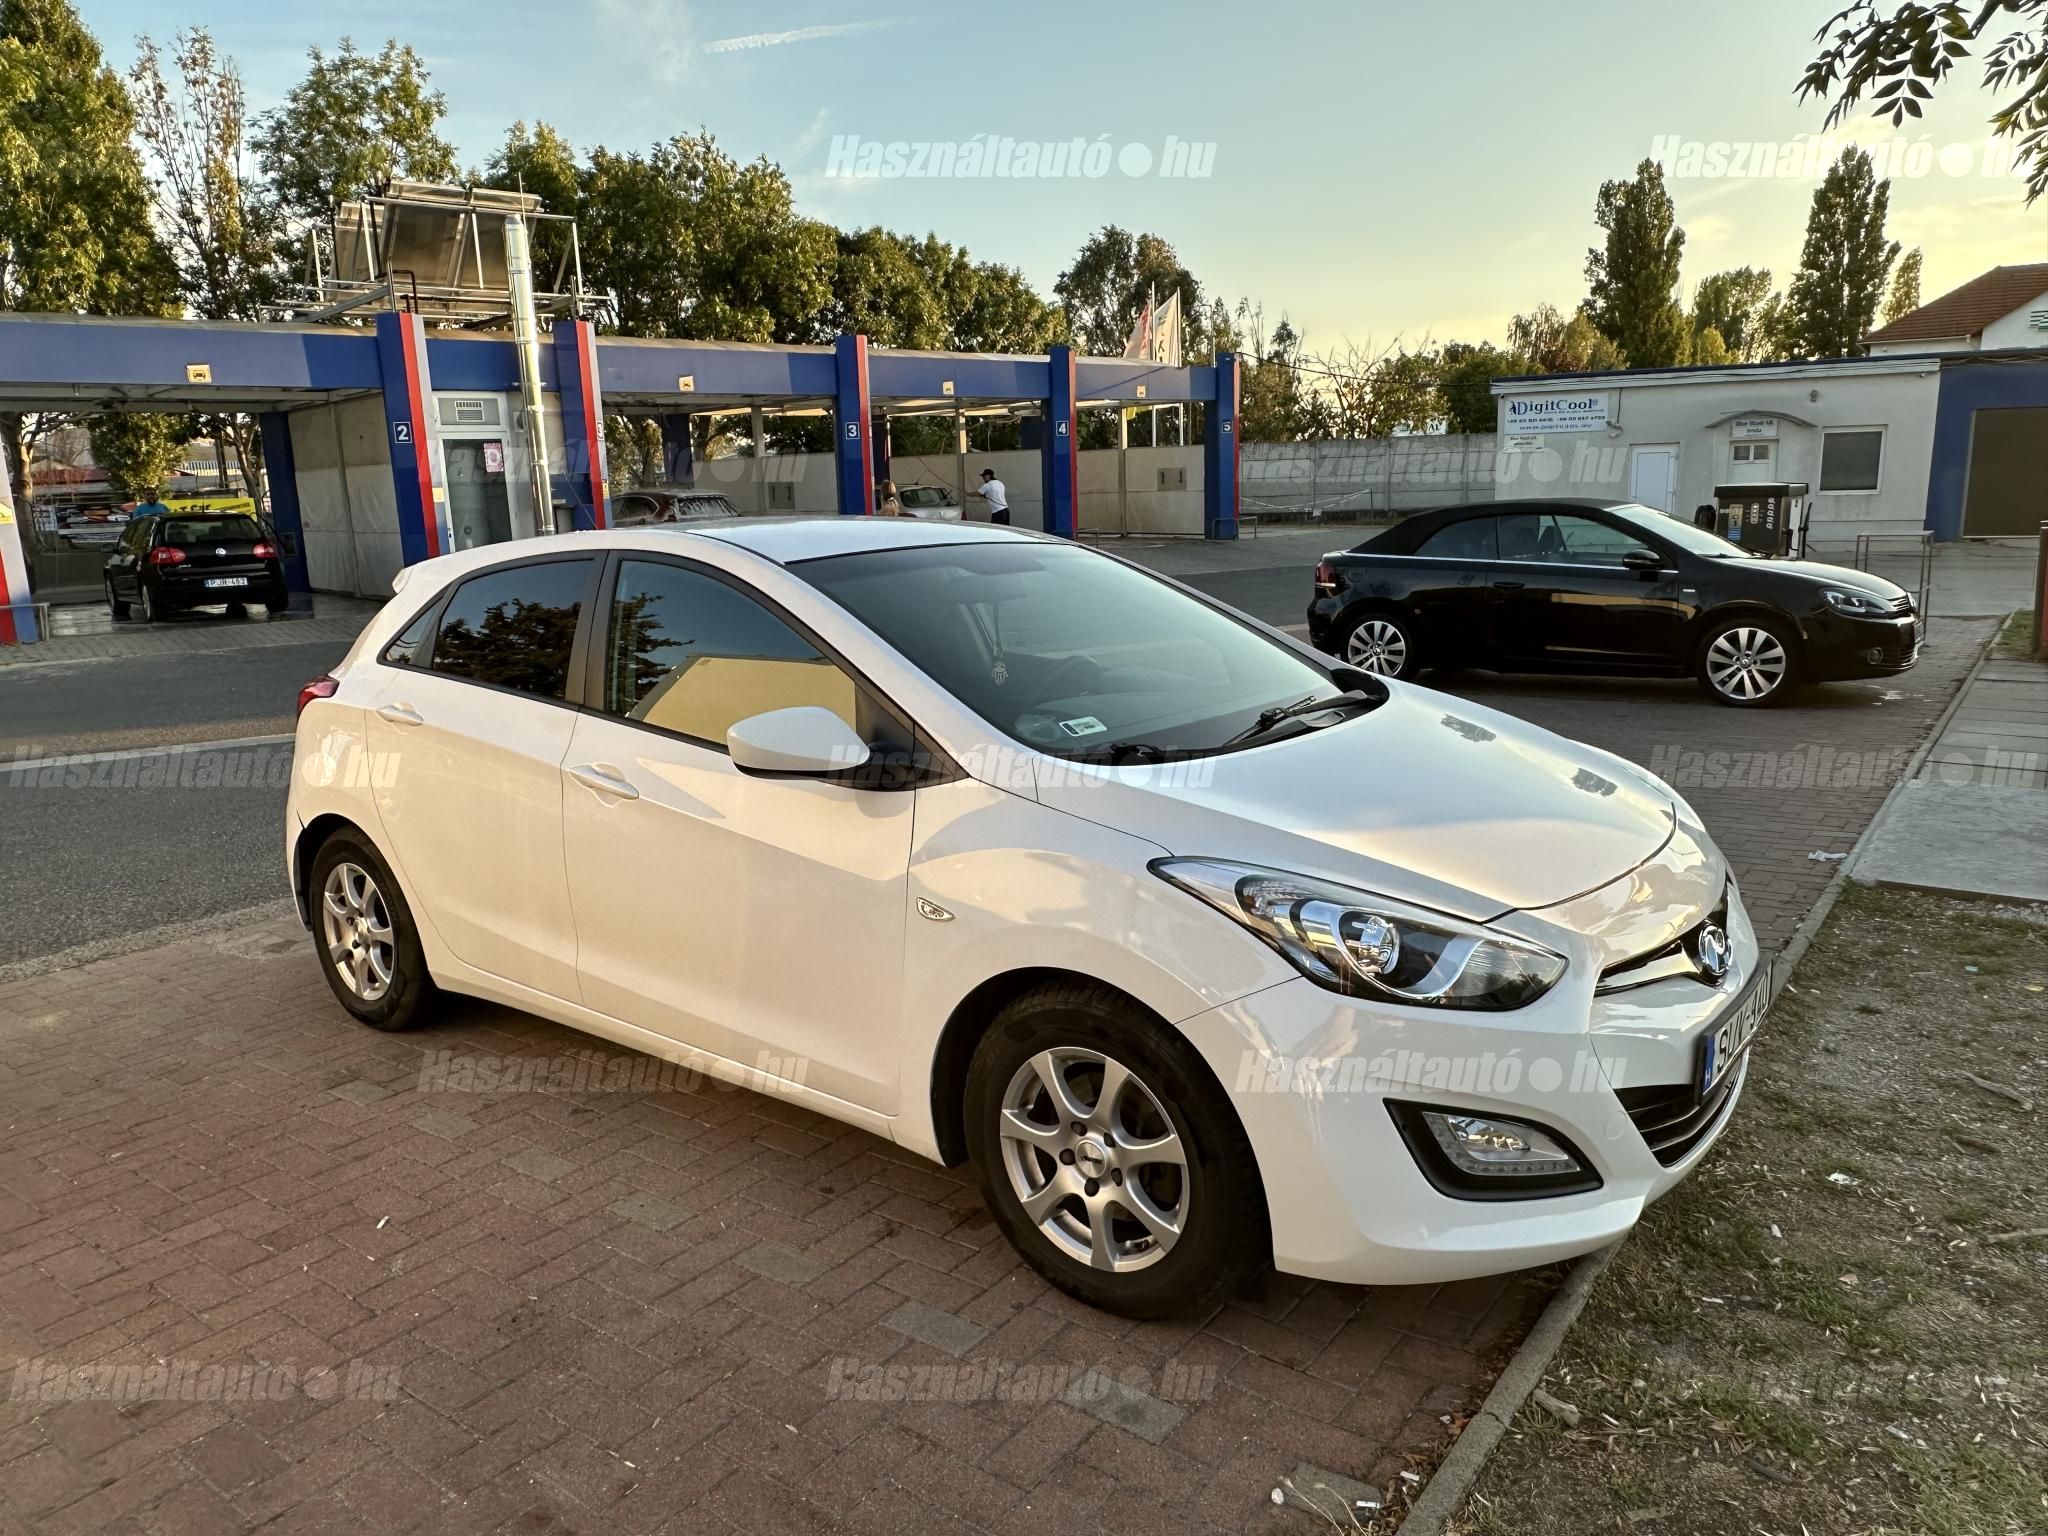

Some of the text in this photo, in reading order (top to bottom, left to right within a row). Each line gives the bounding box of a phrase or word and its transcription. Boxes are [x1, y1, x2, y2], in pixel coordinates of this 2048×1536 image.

[1516, 398, 1593, 415] DigitCool
[397, 425, 408, 440] 2
[848, 424, 857, 437] 3
[1058, 422, 1066, 434] 4
[1224, 421, 1231, 431] 5
